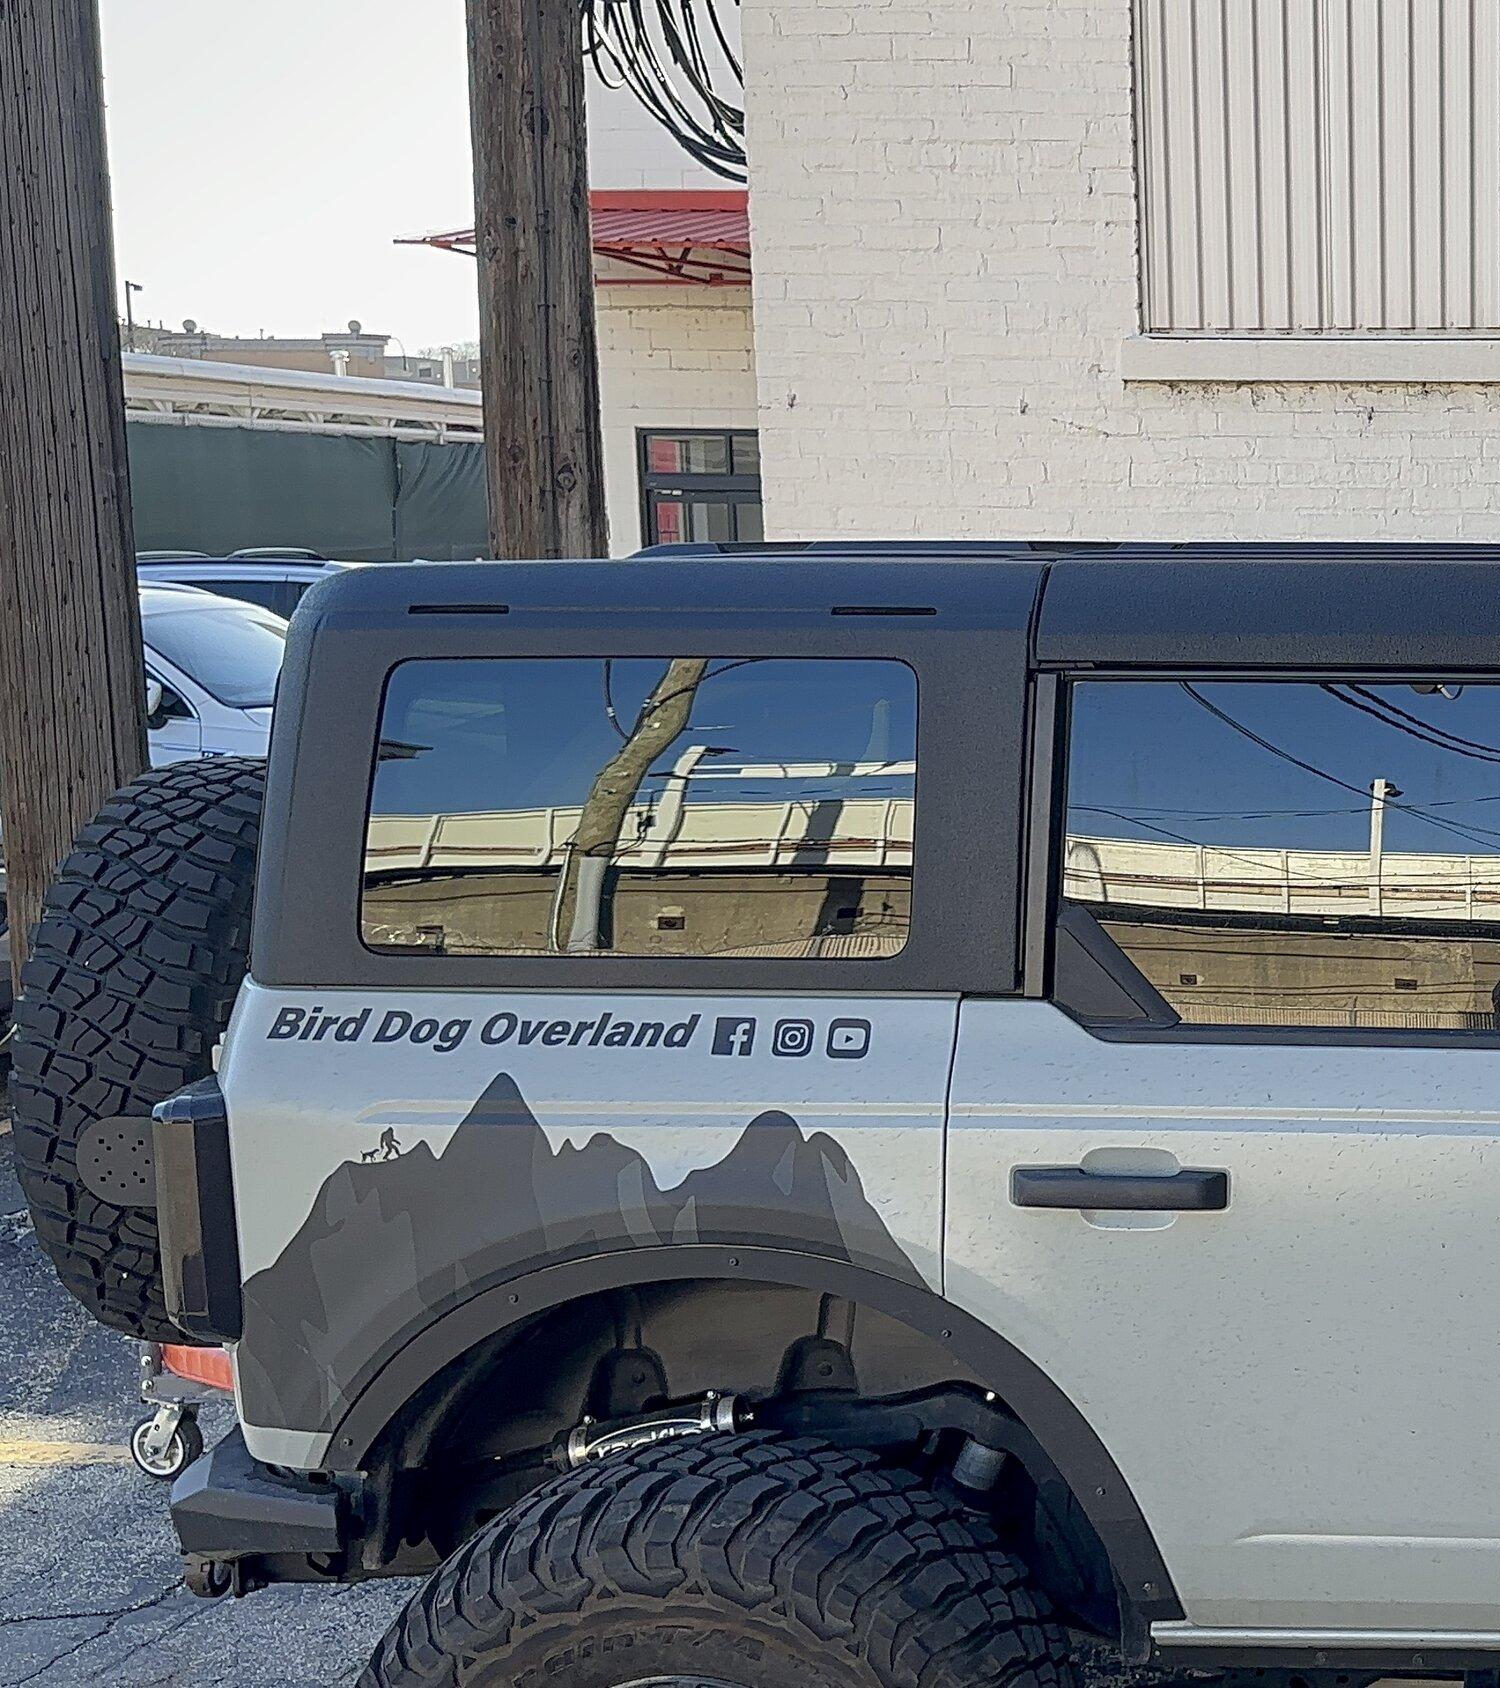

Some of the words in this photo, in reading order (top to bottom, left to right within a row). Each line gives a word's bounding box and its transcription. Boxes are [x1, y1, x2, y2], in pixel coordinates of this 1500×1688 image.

[266, 1007, 373, 1042] Bird
[372, 1011, 473, 1053] Dog
[480, 1012, 702, 1048] Overland
